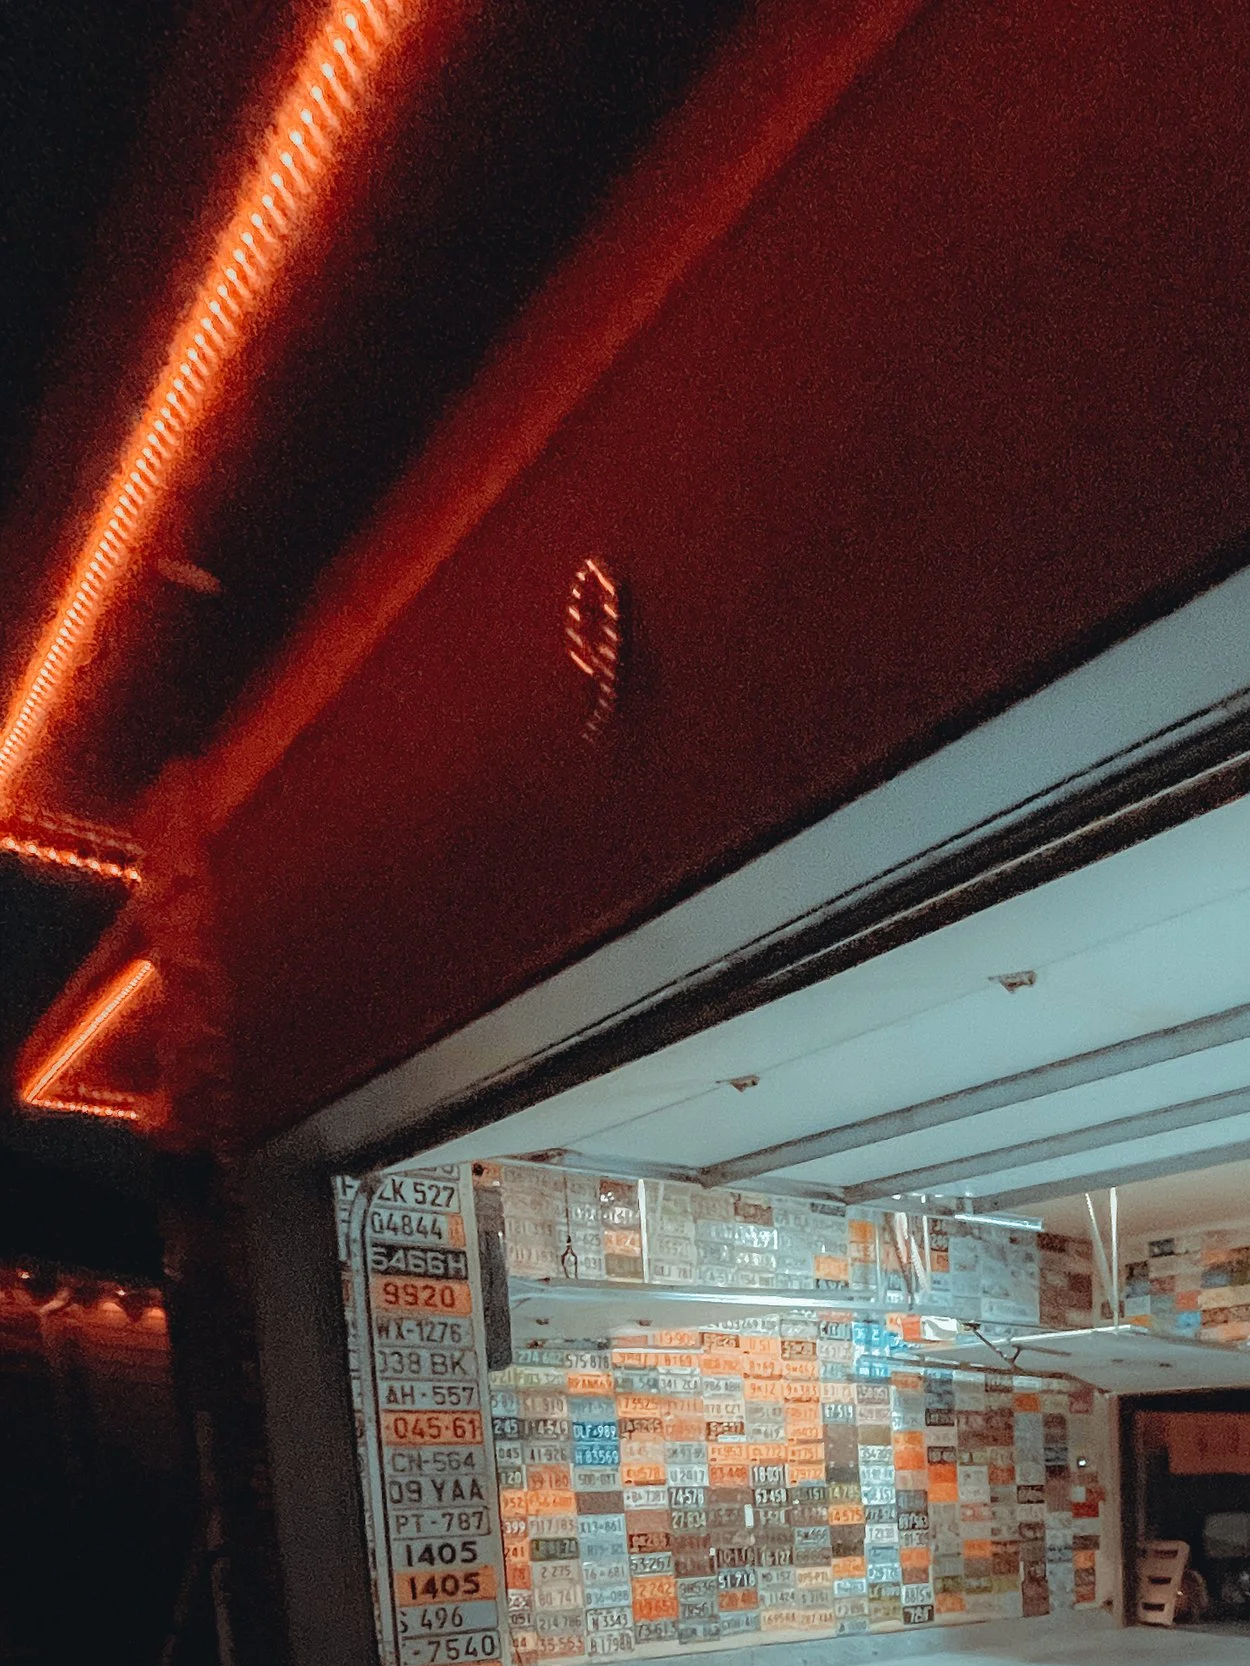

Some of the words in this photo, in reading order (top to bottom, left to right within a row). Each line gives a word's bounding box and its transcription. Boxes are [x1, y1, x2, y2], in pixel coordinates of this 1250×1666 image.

[413, 1181, 455, 1208] 527
[383, 1281, 455, 1309] 9920
[405, 1540, 479, 1567] 1405
[410, 1572, 481, 1600] 1405
[420, 1606, 464, 1631] 496
